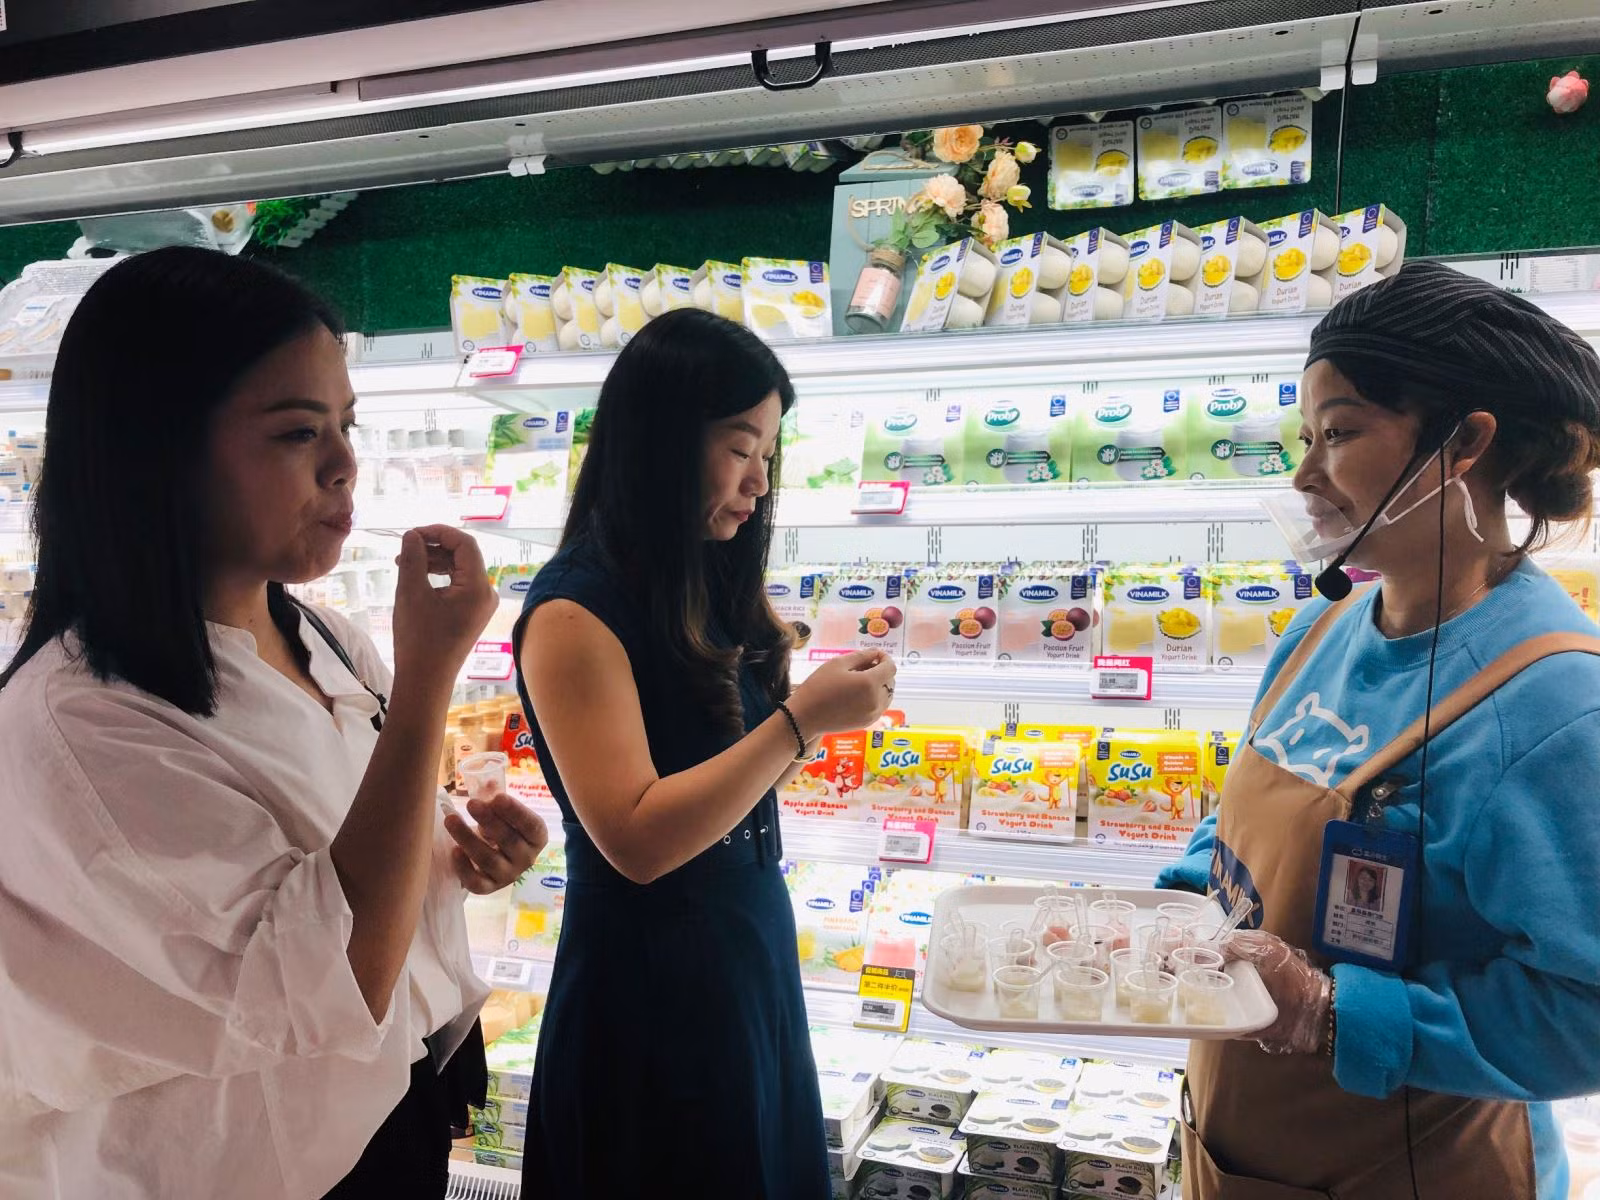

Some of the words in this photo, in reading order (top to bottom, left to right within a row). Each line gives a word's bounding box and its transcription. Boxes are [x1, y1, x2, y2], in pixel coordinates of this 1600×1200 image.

[764, 272, 798, 282] VINAMILK
[1276, 286, 1298, 296] Durian
[1339, 281, 1362, 291] Durian
[473, 288, 502, 299] VINAMIL
[1209, 397, 1245, 413] Proby
[986, 407, 1020, 423] Proby
[1098, 404, 1131, 421] Proby
[841, 589, 873, 597] VINAMILK
[930, 589, 964, 597] VINAMILK
[1021, 589, 1057, 598] VINAMILK
[1129, 590, 1167, 598] VINAMILK
[1238, 589, 1277, 598] VINAMILK
[1043, 643, 1067, 651] Passion
[1166, 643, 1192, 652] Durian
[880, 750, 920, 768] SuSu
[991, 758, 1033, 774] SuSu
[1108, 762, 1152, 781] SuSu
[783, 800, 804, 808] Apple
[820, 802, 848, 810] Banana
[871, 803, 913, 814] Strawberry
[928, 808, 955, 816] Banana
[981, 809, 1025, 820] Strawberry
[1041, 813, 1070, 821] Banana
[998, 818, 1027, 828] Yogurt
[1029, 820, 1053, 828] Drink
[1099, 819, 1146, 831] Strawberry
[1163, 824, 1194, 833] Banana
[1119, 830, 1149, 840] Yogurt
[1152, 832, 1177, 841] Drink
[901, 914, 931, 922] VINAMIL
